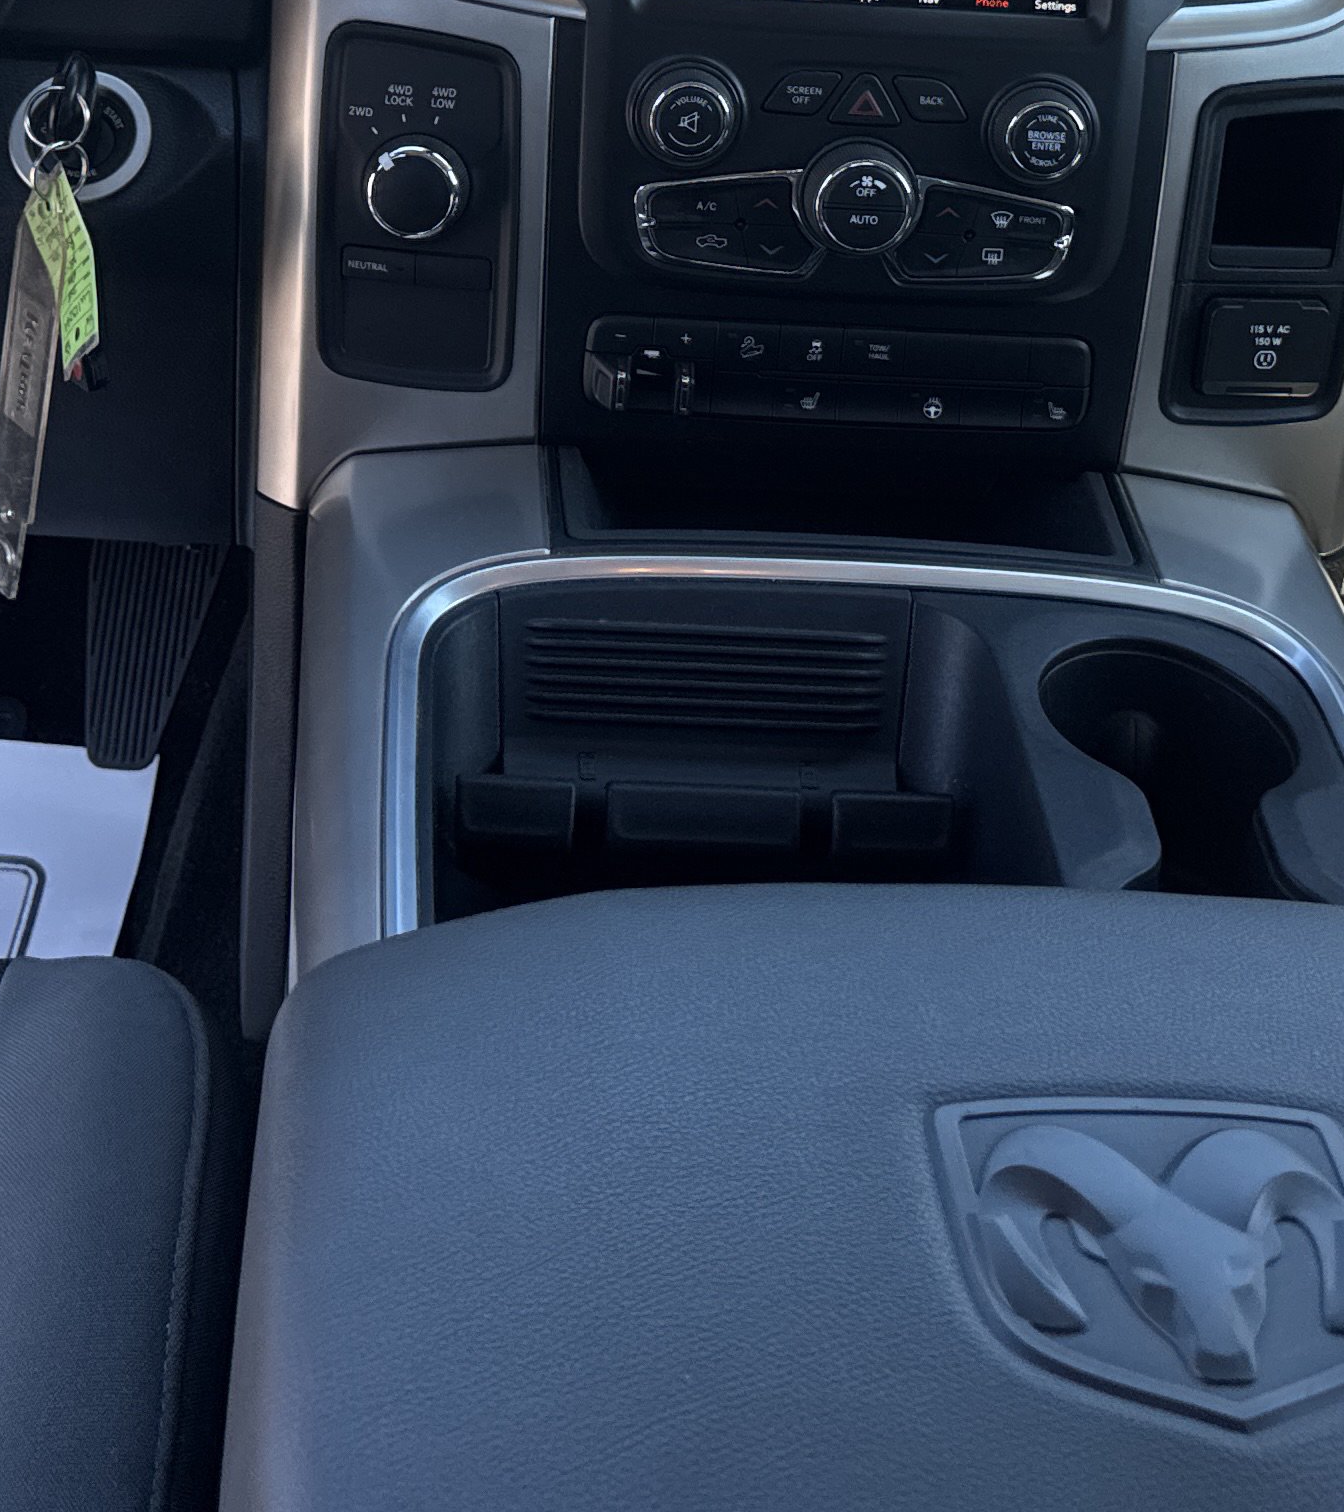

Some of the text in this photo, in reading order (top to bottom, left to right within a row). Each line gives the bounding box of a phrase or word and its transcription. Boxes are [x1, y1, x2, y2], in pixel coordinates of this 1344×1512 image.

[387, 83, 414, 96] 4WD
[432, 86, 457, 98] 4WD
[786, 85, 823, 95] SCREEN
[384, 94, 414, 107] LOCK
[430, 97, 456, 109] LOW
[675, 95, 708, 108] VOLUME
[792, 96, 812, 105] OFF
[919, 96, 944, 105] BACK
[348, 105, 374, 117] 2WD
[1027, 130, 1067, 141] BROWSE
[1031, 141, 1062, 152] ENTER
[856, 188, 877, 198] OFF
[696, 199, 718, 213] A/C
[849, 214, 879, 226] AUTO
[1018, 215, 1047, 226] FRONT
[347, 259, 389, 274] NEUTRAL
[1249, 324, 1291, 334] 115 V AC
[1254, 337, 1283, 346] 150 W
[806, 353, 823, 361] OFF
